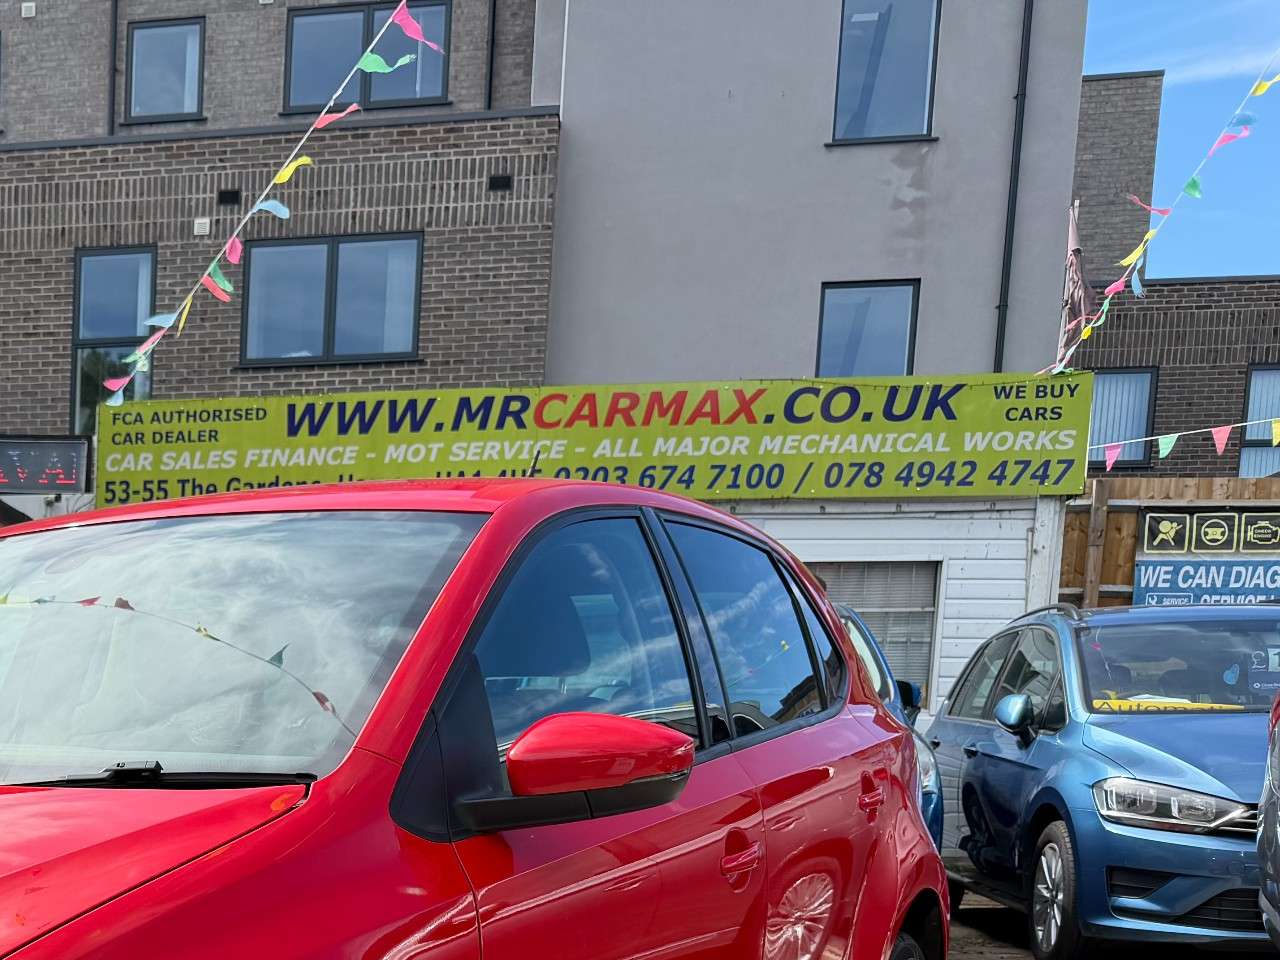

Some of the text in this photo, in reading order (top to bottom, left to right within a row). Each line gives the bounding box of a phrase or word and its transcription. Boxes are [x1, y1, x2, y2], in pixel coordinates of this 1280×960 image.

[993, 383, 1080, 400] WE BUY
[112, 407, 267, 426] FCA AUTHORISED
[287, 383, 969, 438] WWW.MRCARMAX.CO.UK
[1005, 406, 1063, 422] CARS
[112, 429, 219, 446] CAR DEALER
[104, 453, 152, 473] CAR
[160, 450, 237, 471] SALES
[245, 444, 360, 468] FINANCE
[384, 443, 445, 464] MOT
[449, 439, 568, 462] SERVICE
[593, 438, 643, 458] ALL
[652, 435, 751, 457] MAJOR
[759, 431, 952, 456] MECHANICAL
[963, 429, 1077, 452] WORKS
[104, 479, 169, 504] 53-55
[177, 477, 218, 498] The
[226, 474, 321, 492] Gard
[638, 465, 696, 490] 674
[706, 463, 785, 490] 7100
[824, 461, 885, 488] 078
[894, 460, 977, 488] 4942
[988, 459, 1075, 487] 4747
[1140, 565, 1280, 588] WE CAN DIAG
